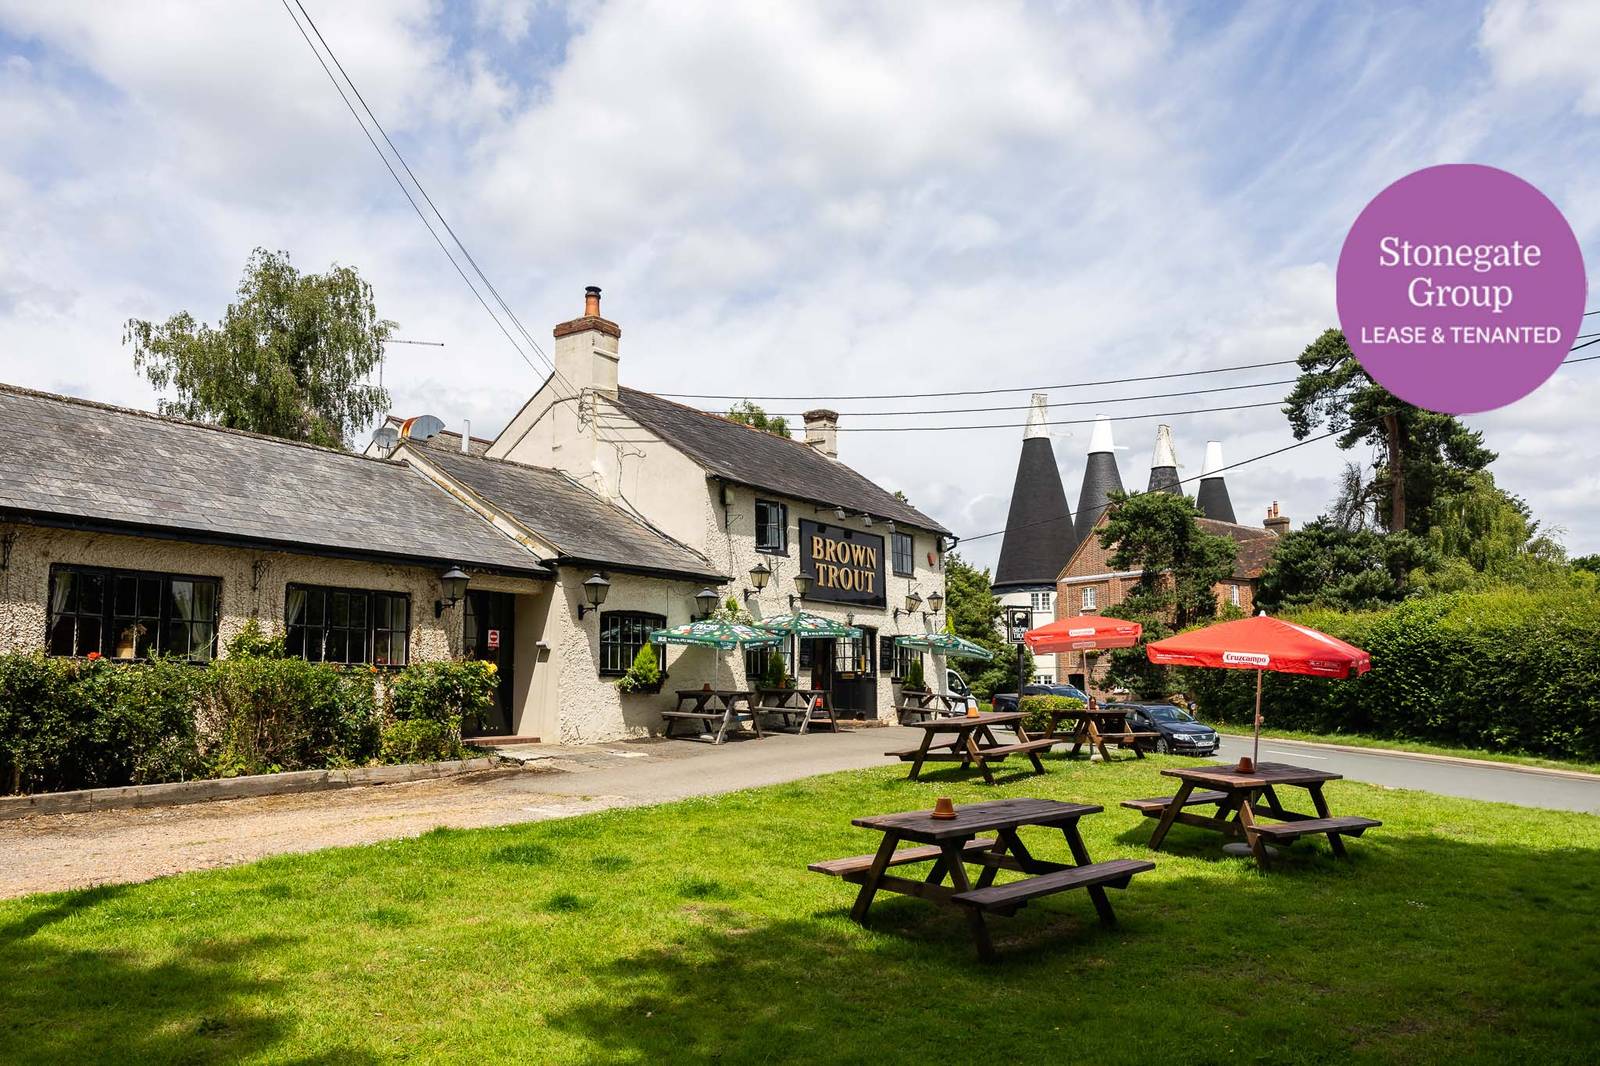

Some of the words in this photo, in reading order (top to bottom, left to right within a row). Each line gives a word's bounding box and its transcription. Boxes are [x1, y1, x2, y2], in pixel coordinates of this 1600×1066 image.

[811, 535, 877, 570] BROWN
[815, 562, 876, 593] TROUT
[1226, 653, 1267, 664] Cruzcampo
